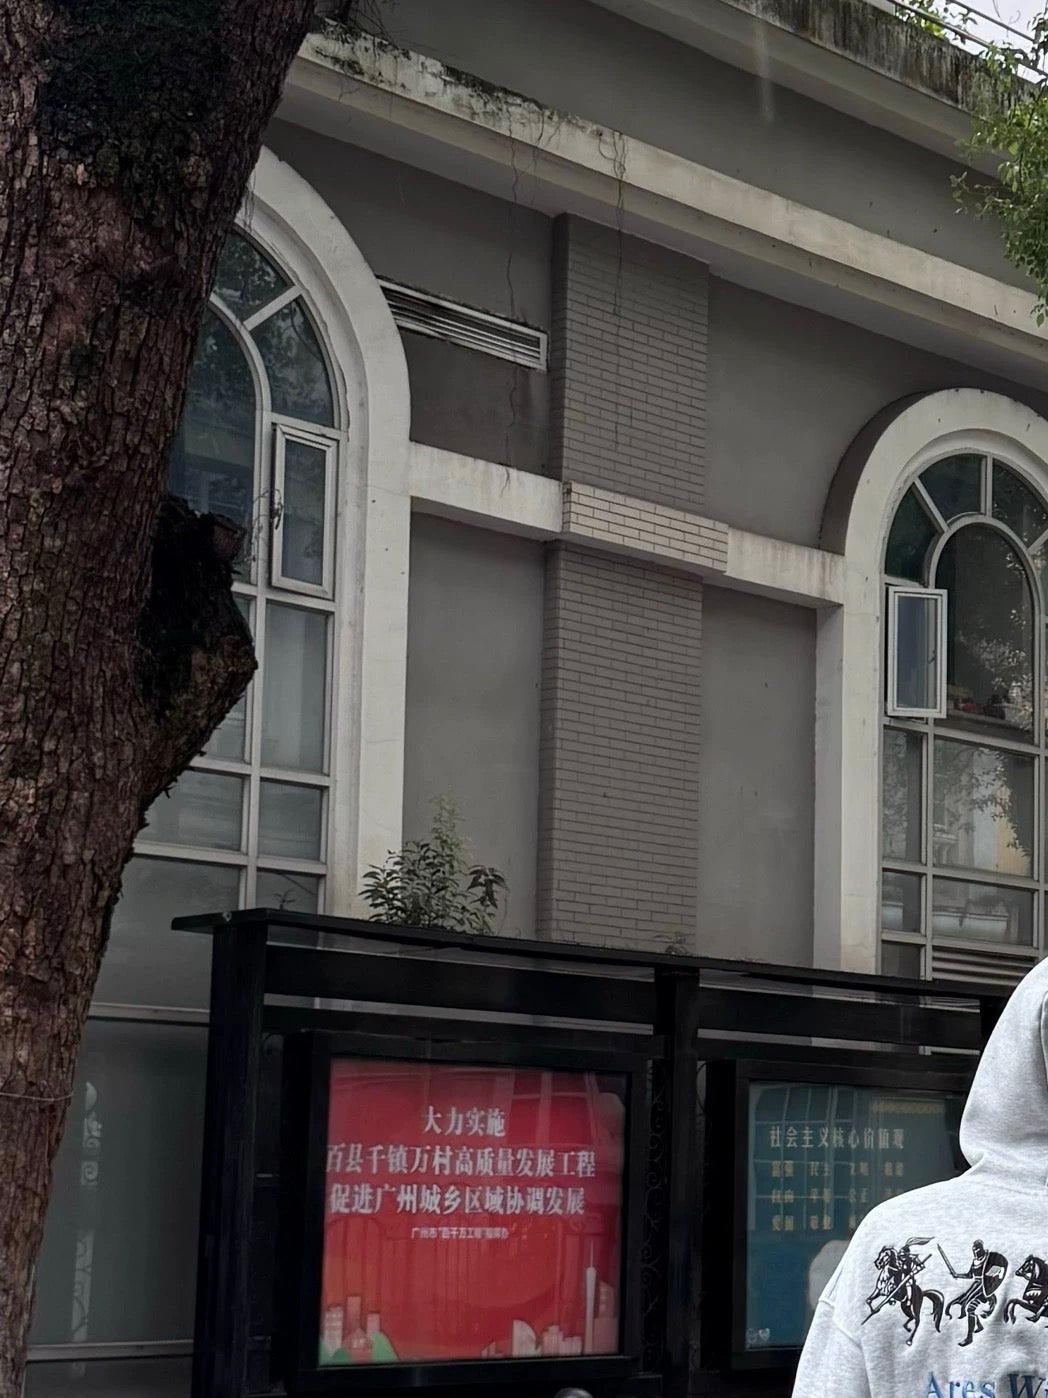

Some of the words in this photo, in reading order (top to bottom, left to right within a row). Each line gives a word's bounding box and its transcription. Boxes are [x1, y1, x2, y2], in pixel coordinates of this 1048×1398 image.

[421, 1105, 506, 1137] 大力实施
[769, 1126, 905, 1150] 社会主义核心价值观
[326, 1143, 596, 1178] 百县千镇万村高质量发展工程
[329, 1183, 586, 1216] 促进广州城乡区域协调发展
